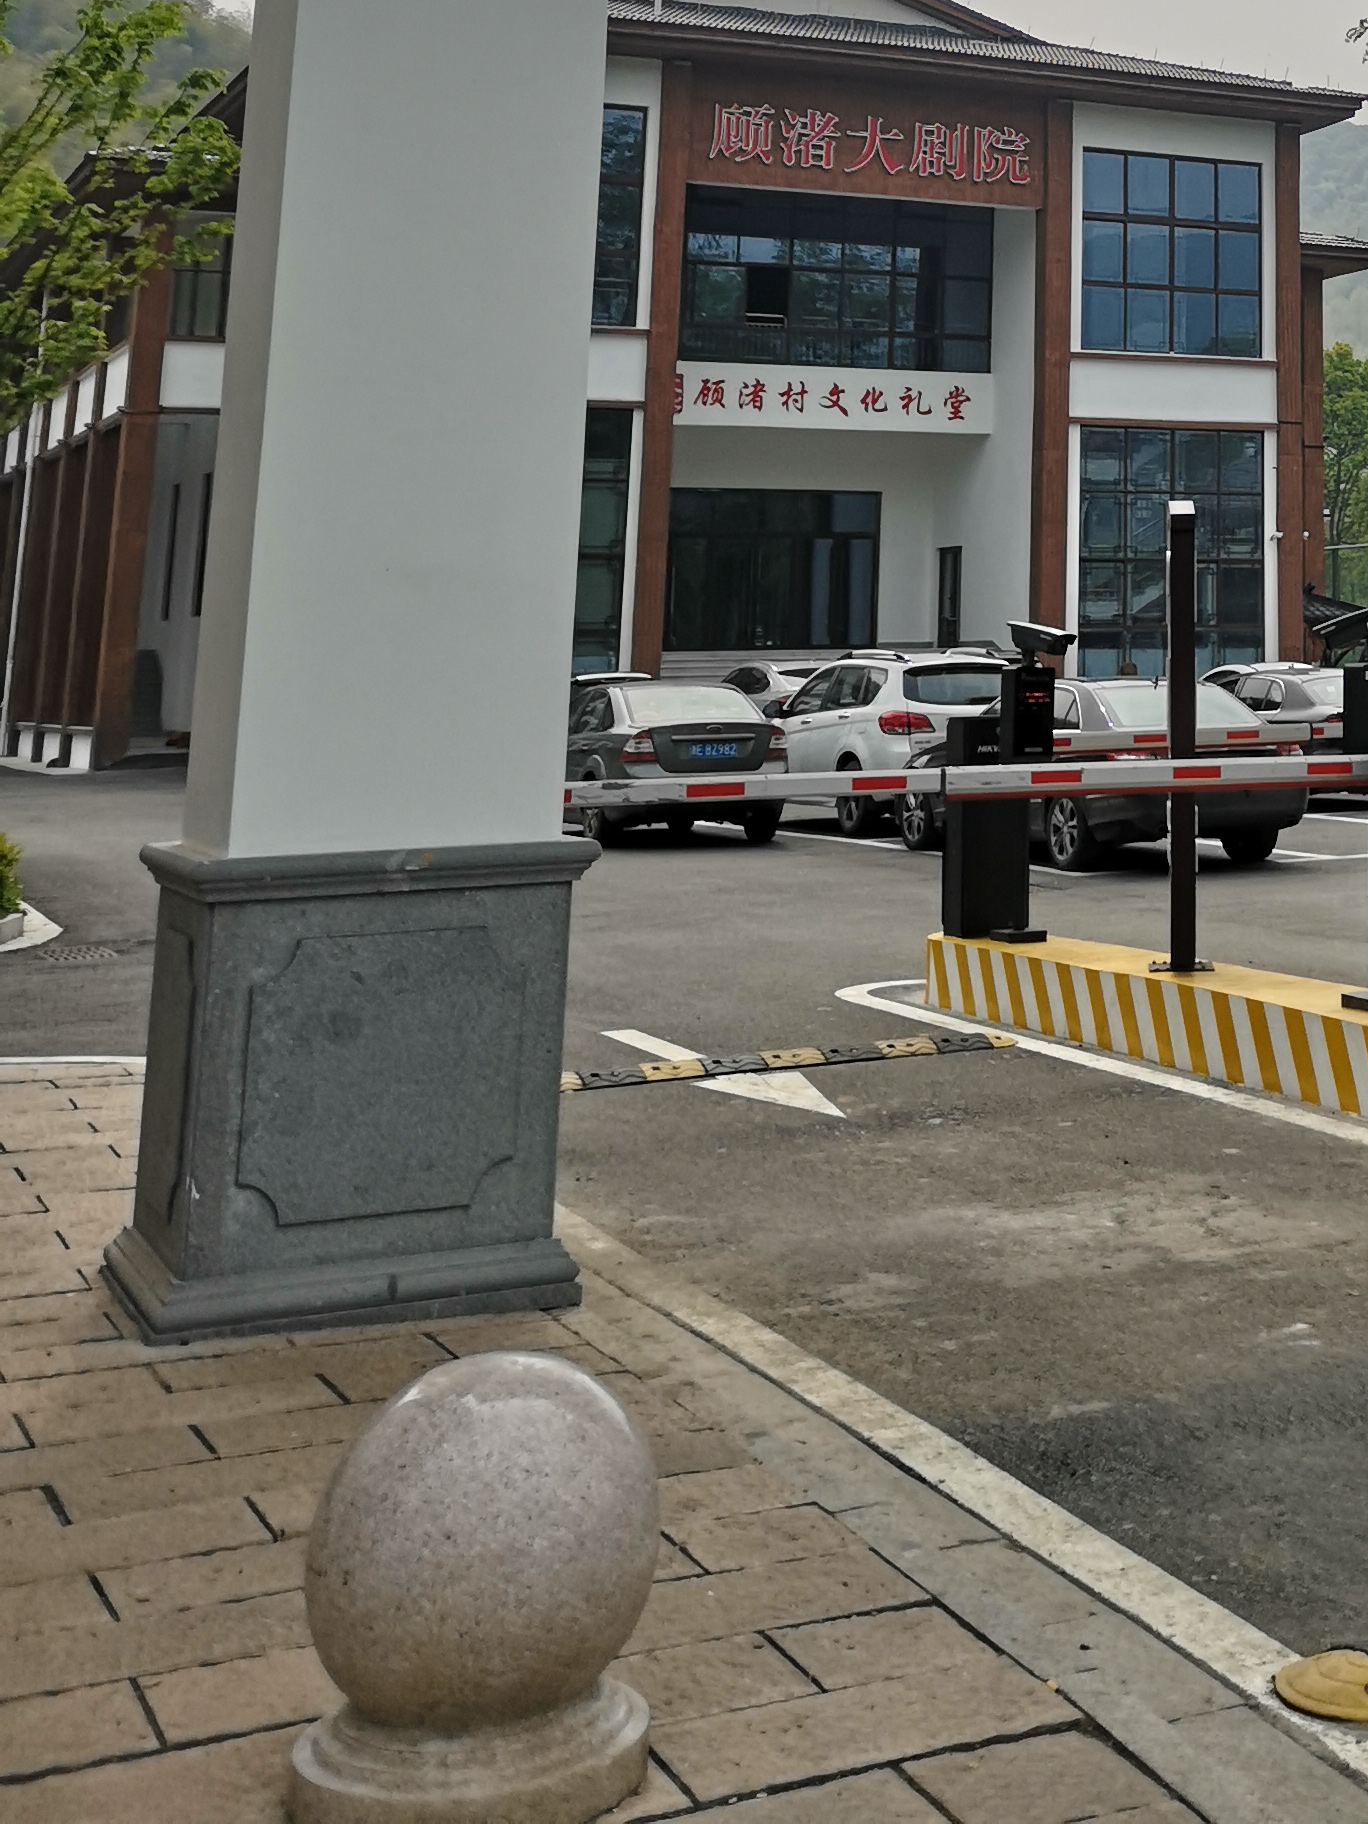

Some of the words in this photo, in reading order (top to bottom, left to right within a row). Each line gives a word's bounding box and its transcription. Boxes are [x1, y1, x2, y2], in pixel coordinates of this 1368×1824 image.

[709, 103, 1031, 185] 顾渚大剧院
[693, 378, 972, 421] 顾渚村文化礼堂
[977, 744, 1000, 753] HIKV
